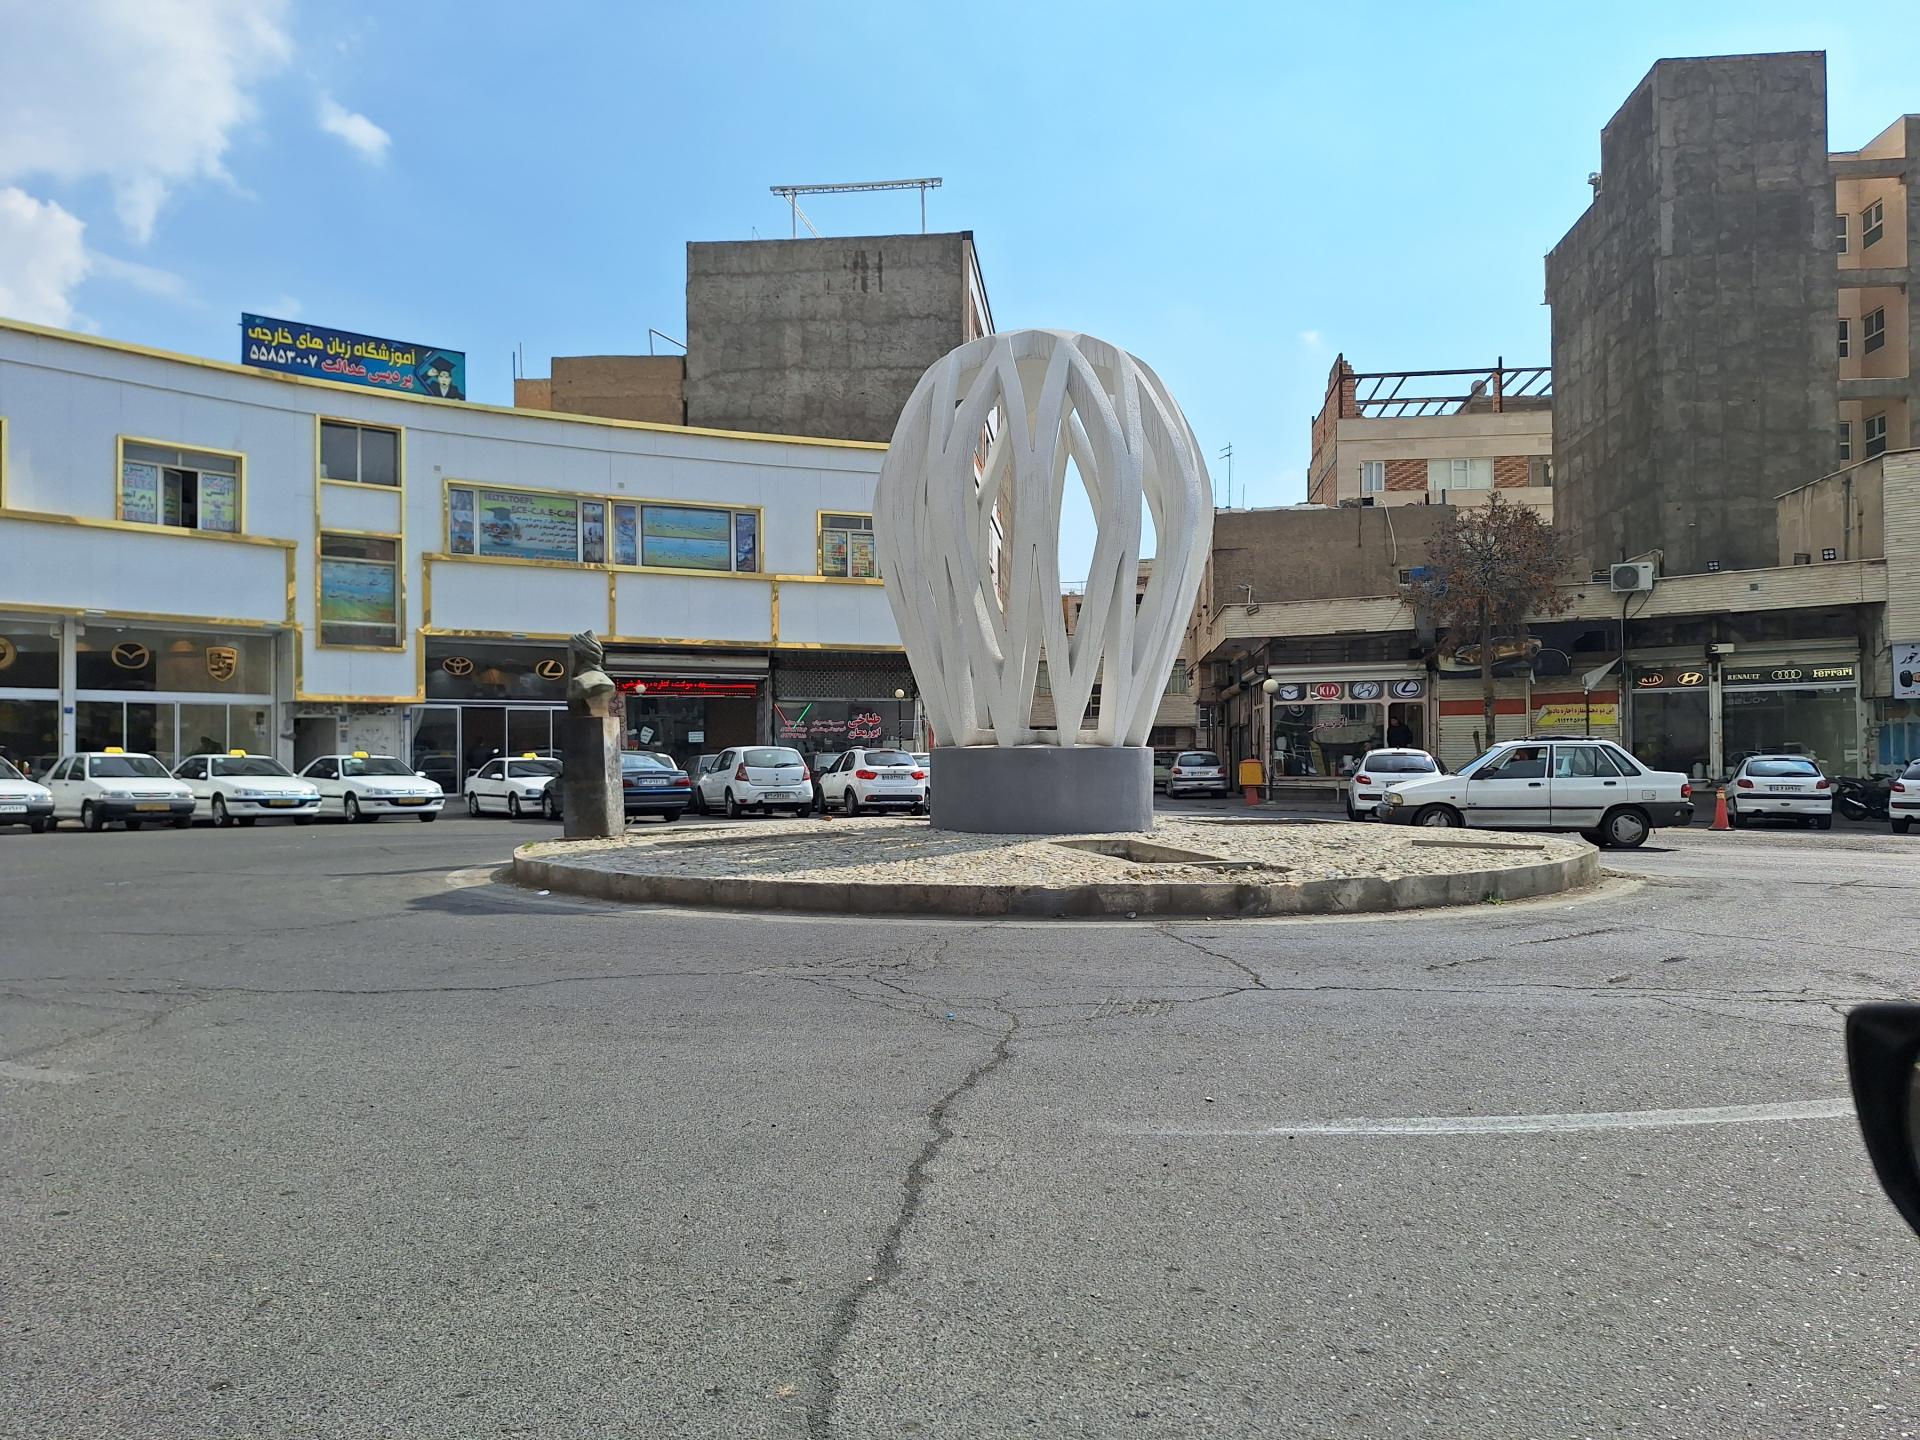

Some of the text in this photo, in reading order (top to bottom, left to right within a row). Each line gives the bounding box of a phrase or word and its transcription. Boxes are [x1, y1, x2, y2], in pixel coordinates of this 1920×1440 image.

[248, 326, 416, 367] آموزشگاه زبان های خارجی
[249, 344, 318, 368] ۵۵۸۵۳۰۰۷
[321, 358, 367, 377] عدالت
[1727, 673, 1760, 681] RENAULT
[1813, 667, 1853, 678] Ferrari
[1319, 686, 1337, 696] KIA
[848, 712, 881, 728] طباخی
